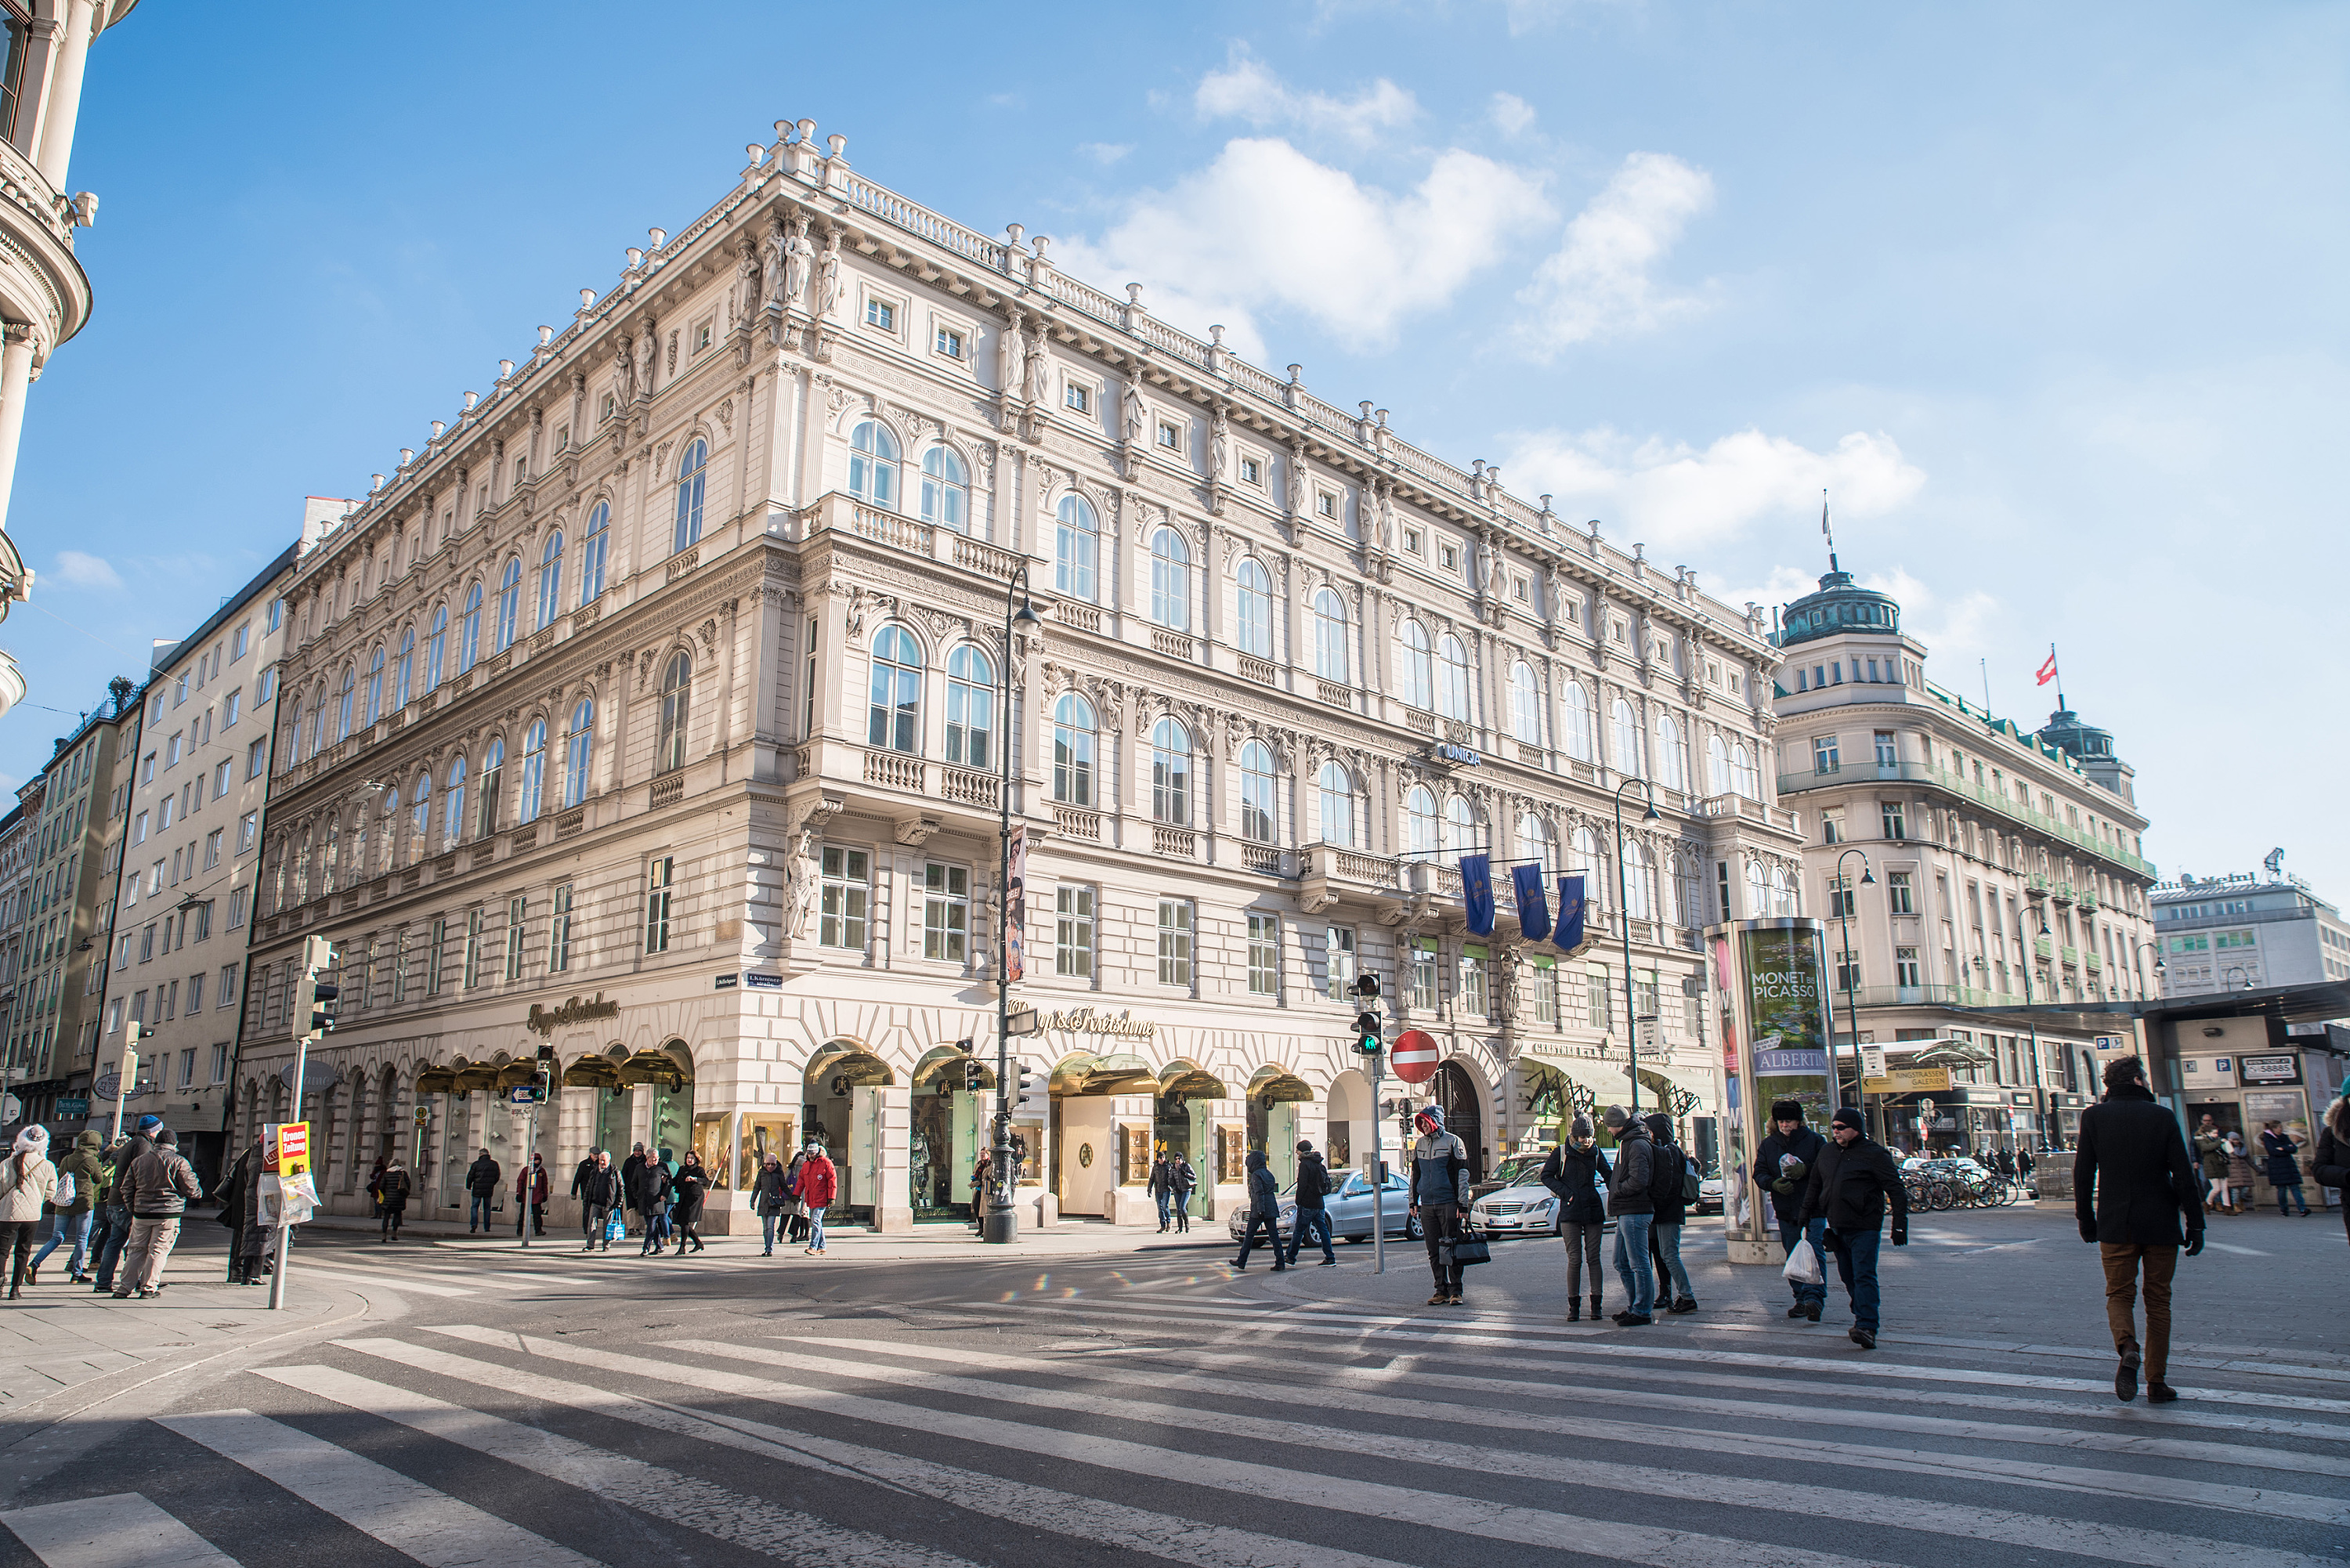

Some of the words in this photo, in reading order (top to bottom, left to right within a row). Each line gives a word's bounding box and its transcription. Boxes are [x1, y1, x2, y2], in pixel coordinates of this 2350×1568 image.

[1447, 743, 1481, 768] UNIQA
[2200, 872, 2255, 885] Meinl
[1752, 971, 1806, 985] MONET
[1753, 985, 1815, 998] PICASSO
[1069, 1005, 1158, 1035] Kretschmer
[1535, 1042, 1580, 1057] GERSTNER
[1896, 1070, 1944, 1079] RINGSTRASSEN
[283, 1130, 306, 1143] Kronen
[283, 1141, 306, 1154] Zeitung
